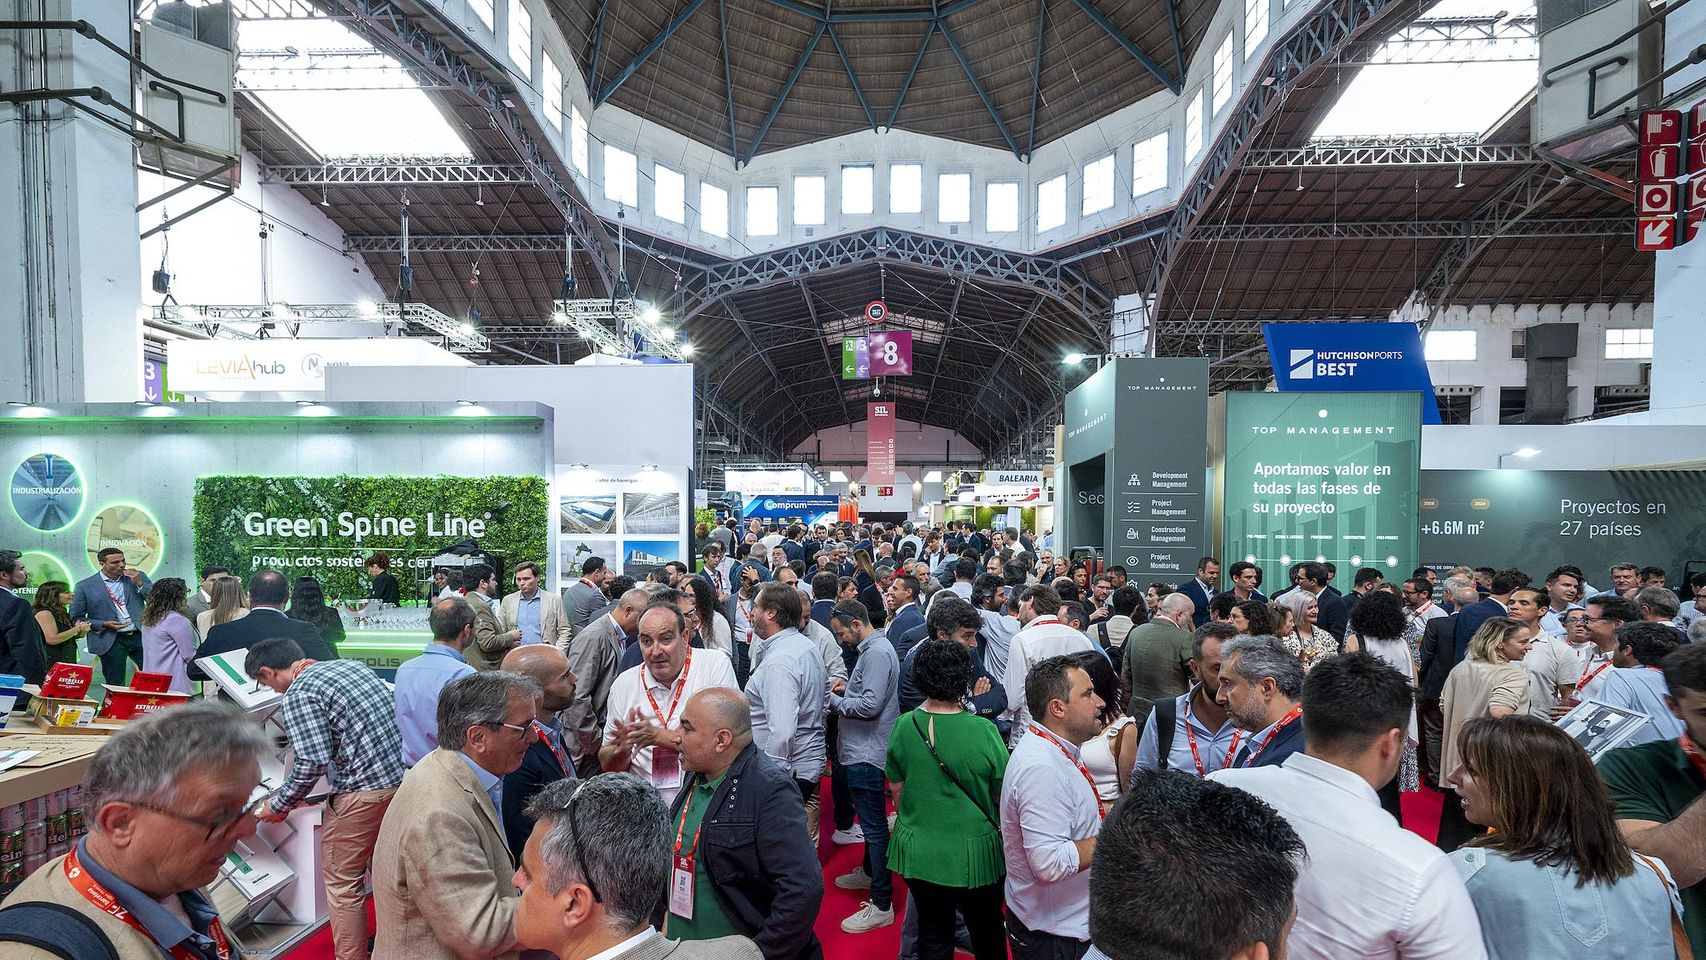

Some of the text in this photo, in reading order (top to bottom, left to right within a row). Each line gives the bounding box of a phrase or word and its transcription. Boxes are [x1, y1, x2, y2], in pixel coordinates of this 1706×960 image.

[883, 341, 899, 366] 8
[1317, 351, 1403, 360] HUTCHISONPORTS
[144, 361, 156, 380] 3
[1316, 363, 1357, 376] BEST
[874, 406, 889, 414] SIL
[1076, 412, 1107, 435] MANAGEMENT
[1251, 426, 1395, 434] TOP MANAGEMENT
[1253, 462, 1391, 478] Aportamos valor en
[1152, 471, 1188, 481] Development
[12, 485, 82, 495] INDUSTRIALIZACIÓN
[1152, 480, 1188, 489] Management
[1253, 481, 1381, 495] todas las fases de
[764, 499, 807, 511] Comprum
[1151, 500, 1173, 509] Project
[1253, 501, 1335, 517] su proyecto
[1560, 499, 1666, 518] Proyectos en
[1151, 508, 1187, 517] Management
[244, 512, 328, 538] Green
[338, 512, 416, 542] Spine
[1151, 525, 1186, 534] Construction
[1421, 520, 1463, 535] +6.6M
[1560, 521, 1641, 539] 27 países
[100, 538, 147, 547] INNOVACIÓN
[1151, 534, 1186, 543] Management
[252, 555, 323, 569] productos
[1150, 553, 1171, 562] Project
[1150, 561, 1180, 570] Monitoring
